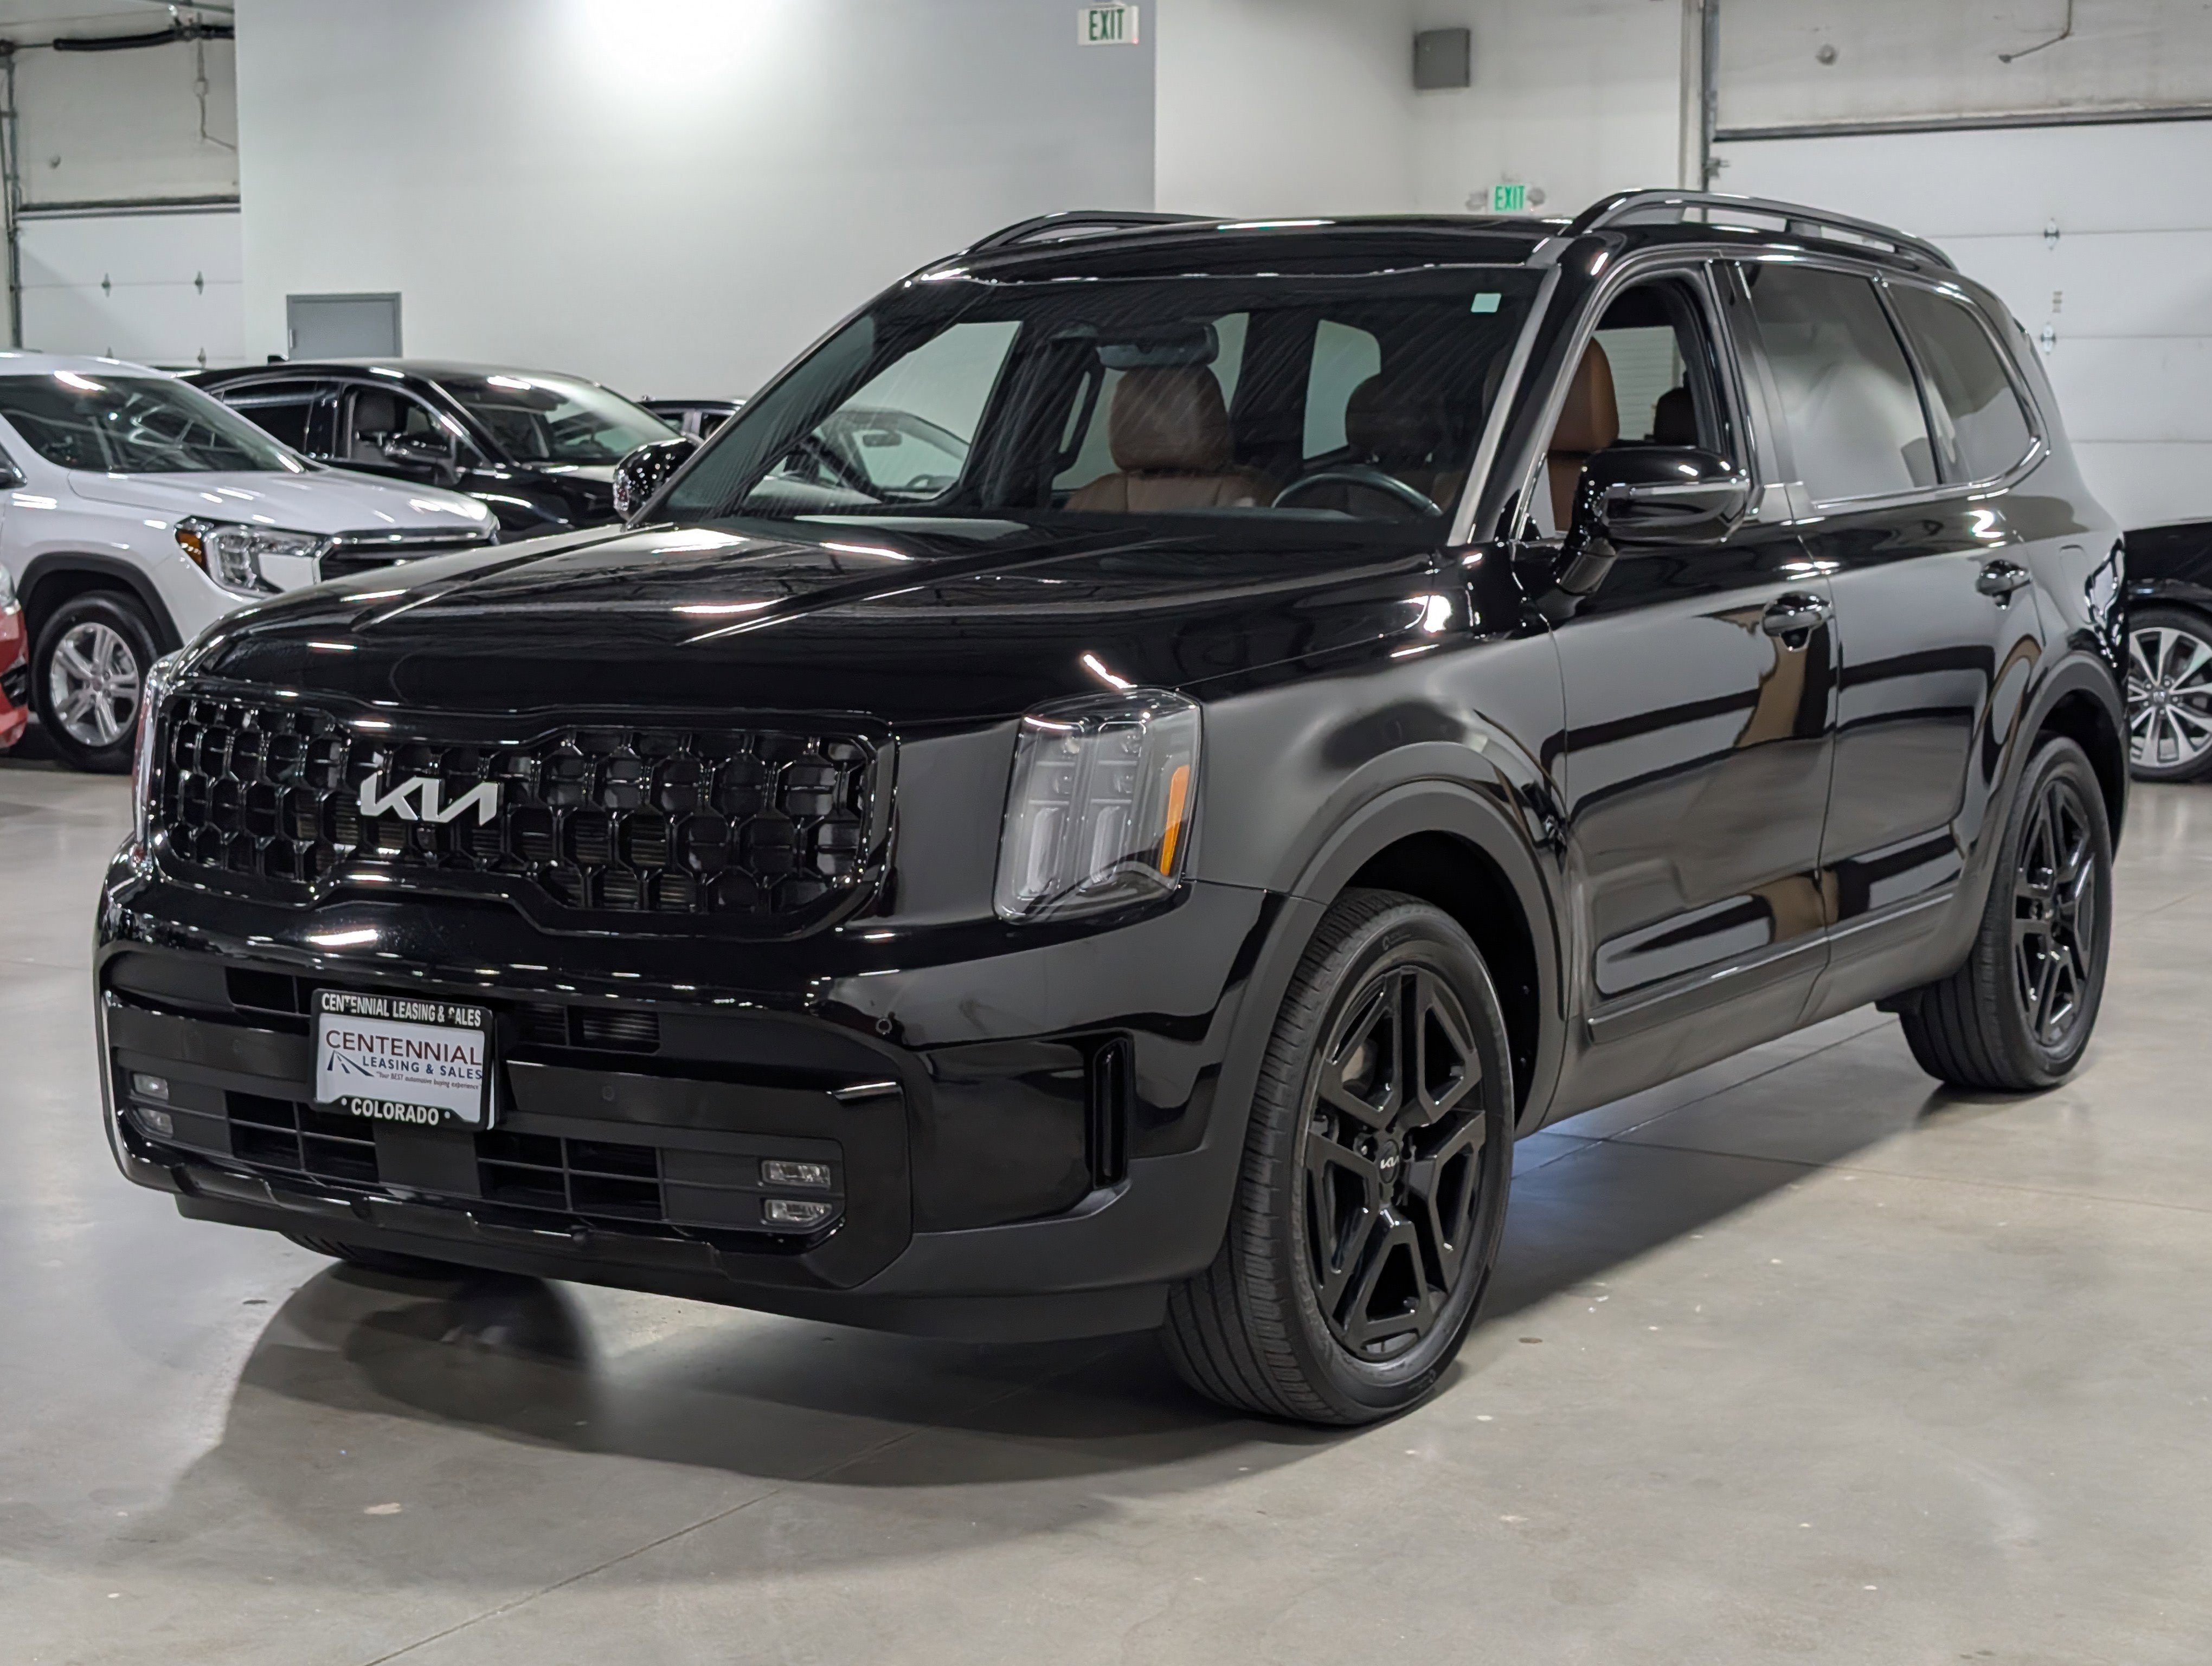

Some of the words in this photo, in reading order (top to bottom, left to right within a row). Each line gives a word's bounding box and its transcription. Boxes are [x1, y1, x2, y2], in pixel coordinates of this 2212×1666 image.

[1089, 9, 1124, 41] EXIT
[1495, 185, 1525, 210] EXIT
[361, 772, 498, 826] KIA
[322, 993, 389, 1017] CENTENNIAL
[393, 1001, 435, 1022] LEASING
[438, 1005, 445, 1022] &
[326, 1030, 482, 1066] CENTENNIAL
[363, 1055, 420, 1074] LEASING
[426, 1063, 434, 1075] &
[440, 1065, 483, 1080] SALES
[352, 1098, 439, 1126] COLORADO
